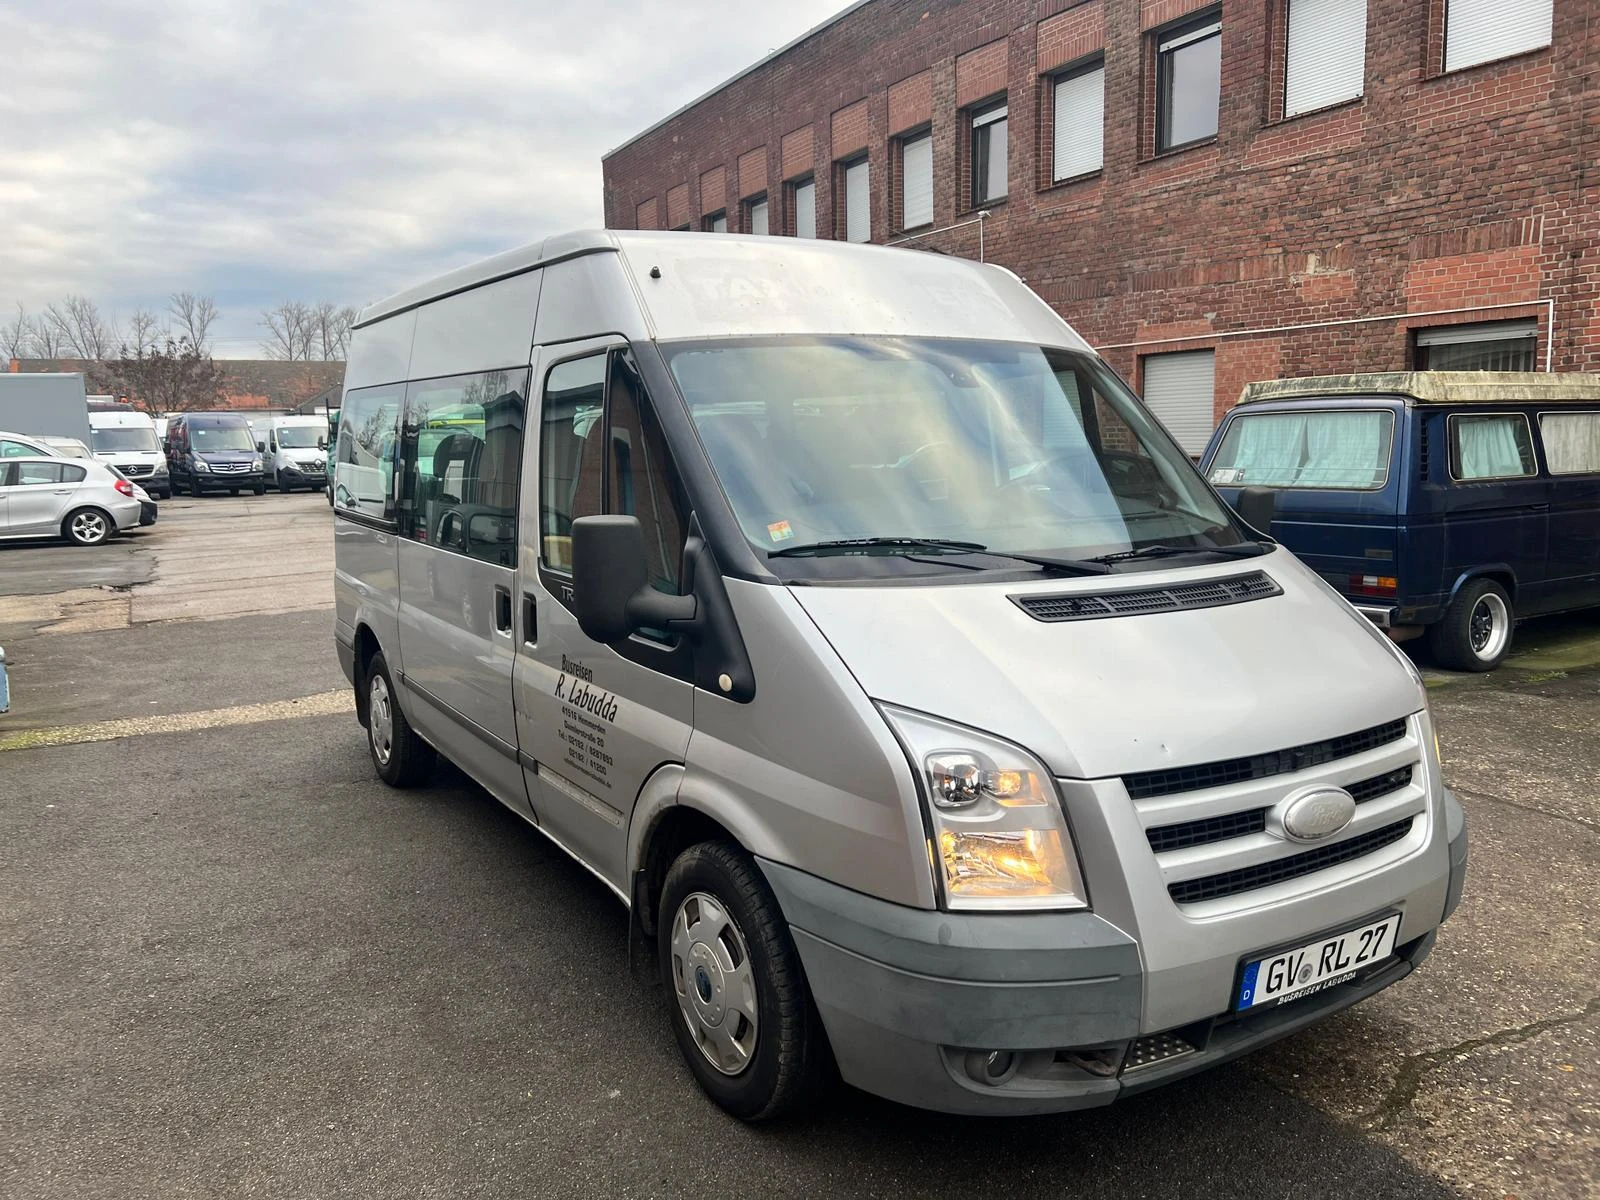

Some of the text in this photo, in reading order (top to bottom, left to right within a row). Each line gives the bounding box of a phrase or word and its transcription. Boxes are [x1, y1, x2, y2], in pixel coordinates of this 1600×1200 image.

[561, 654, 593, 683] Busreisen
[554, 673, 618, 723] R. Labudda
[1265, 923, 1389, 994] GV RL 27
[1242, 989, 1251, 1001] D
[1277, 971, 1358, 1006] BUSREISEN LABUDDA
